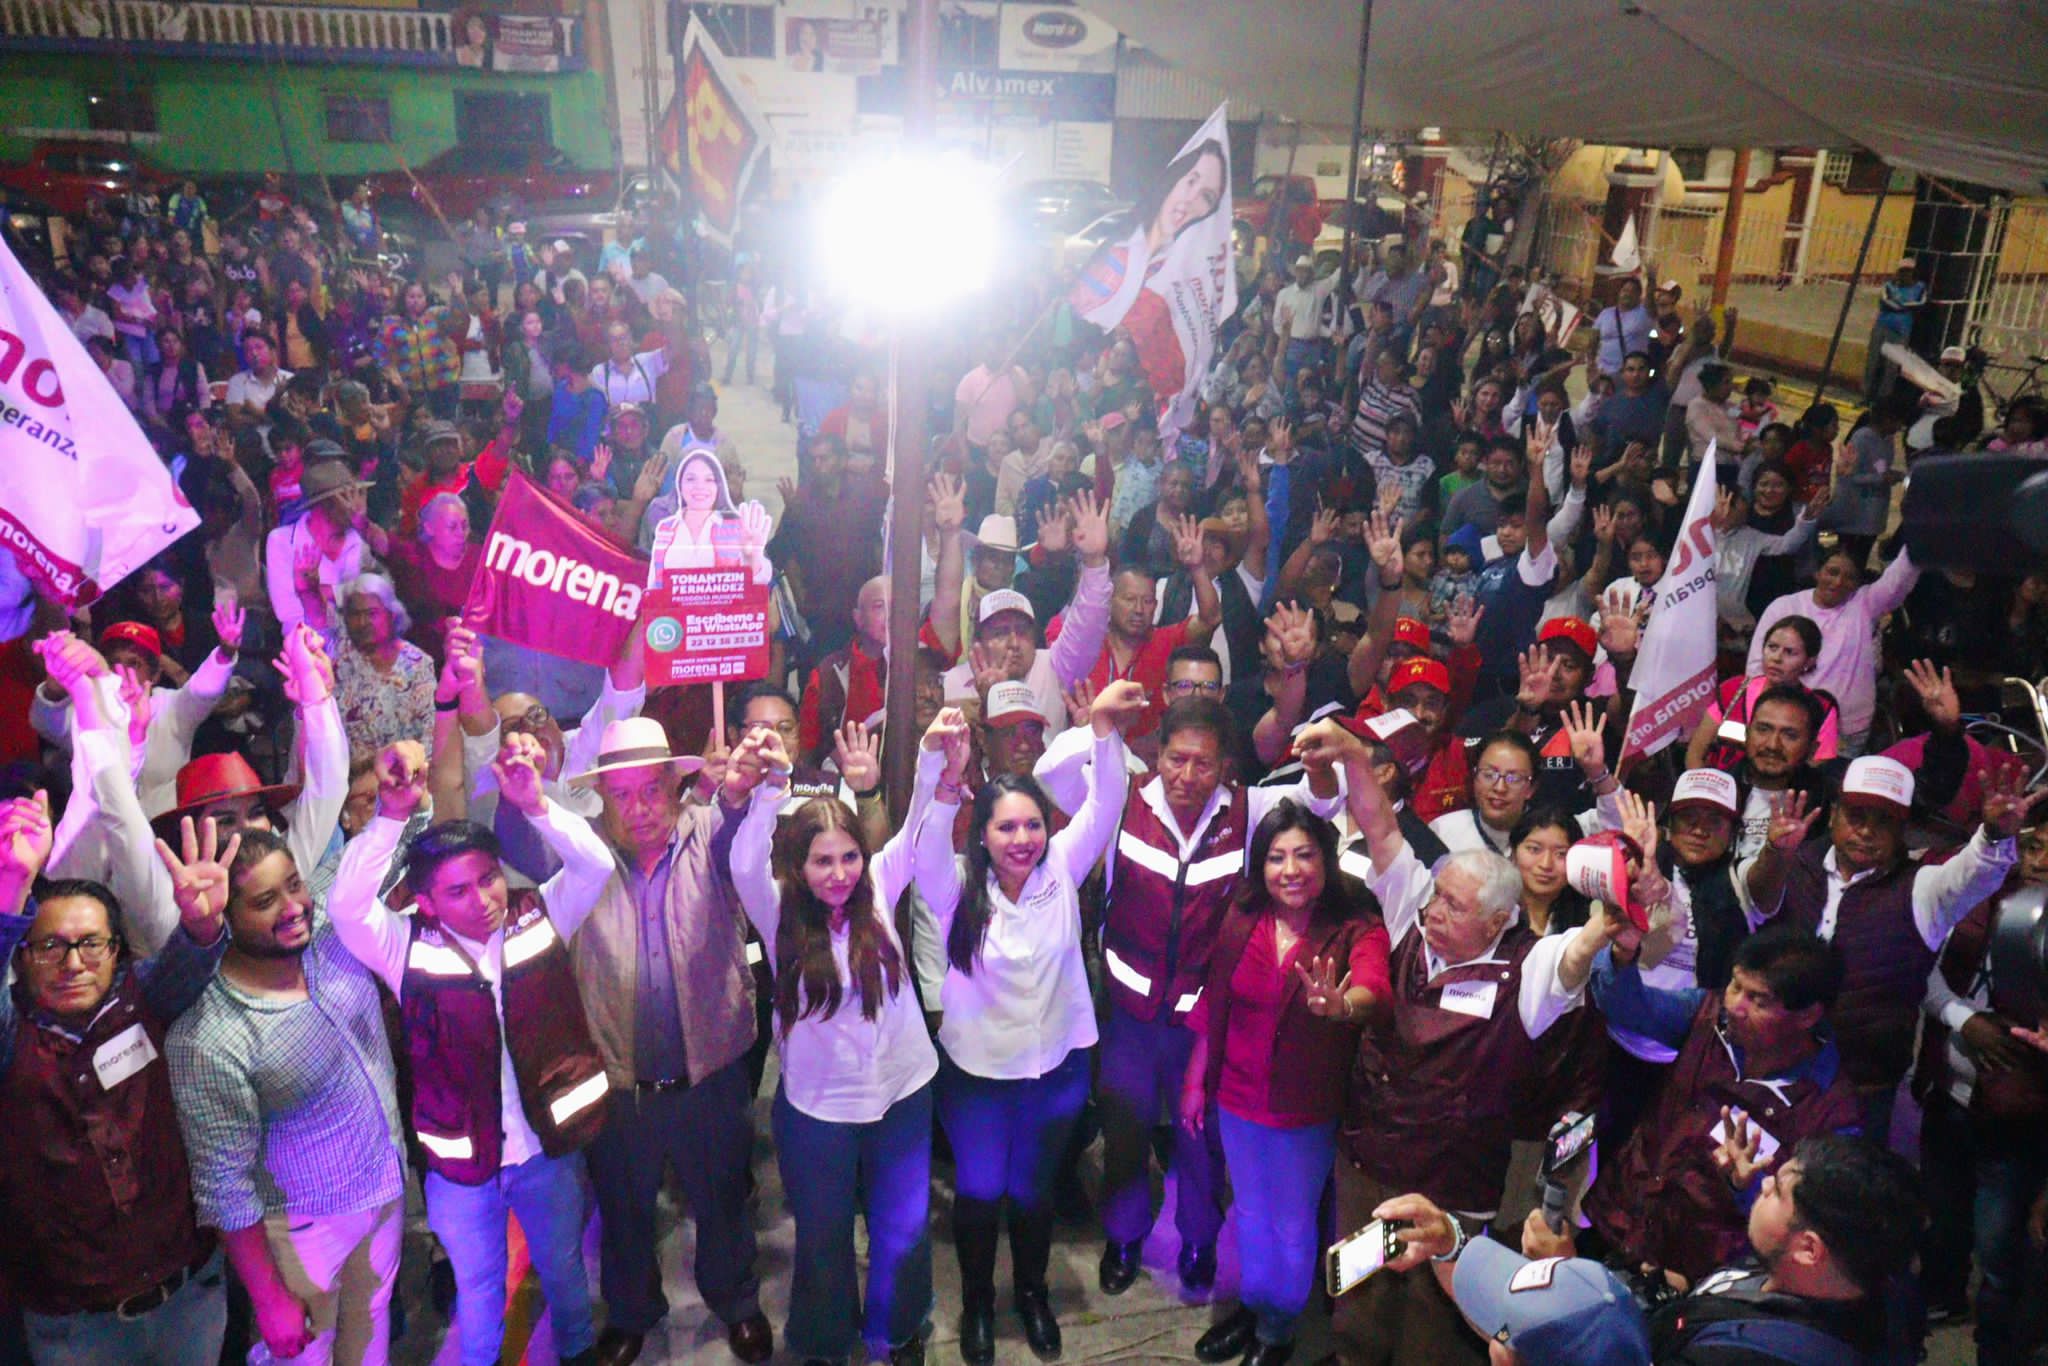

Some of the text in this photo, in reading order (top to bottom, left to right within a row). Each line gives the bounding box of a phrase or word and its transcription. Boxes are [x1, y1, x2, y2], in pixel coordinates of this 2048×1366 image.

[485, 531, 642, 620] morena
[671, 572, 745, 585] TONANTZIN
[704, 621, 764, 633] WhatsApp
[672, 663, 718, 674] morena
